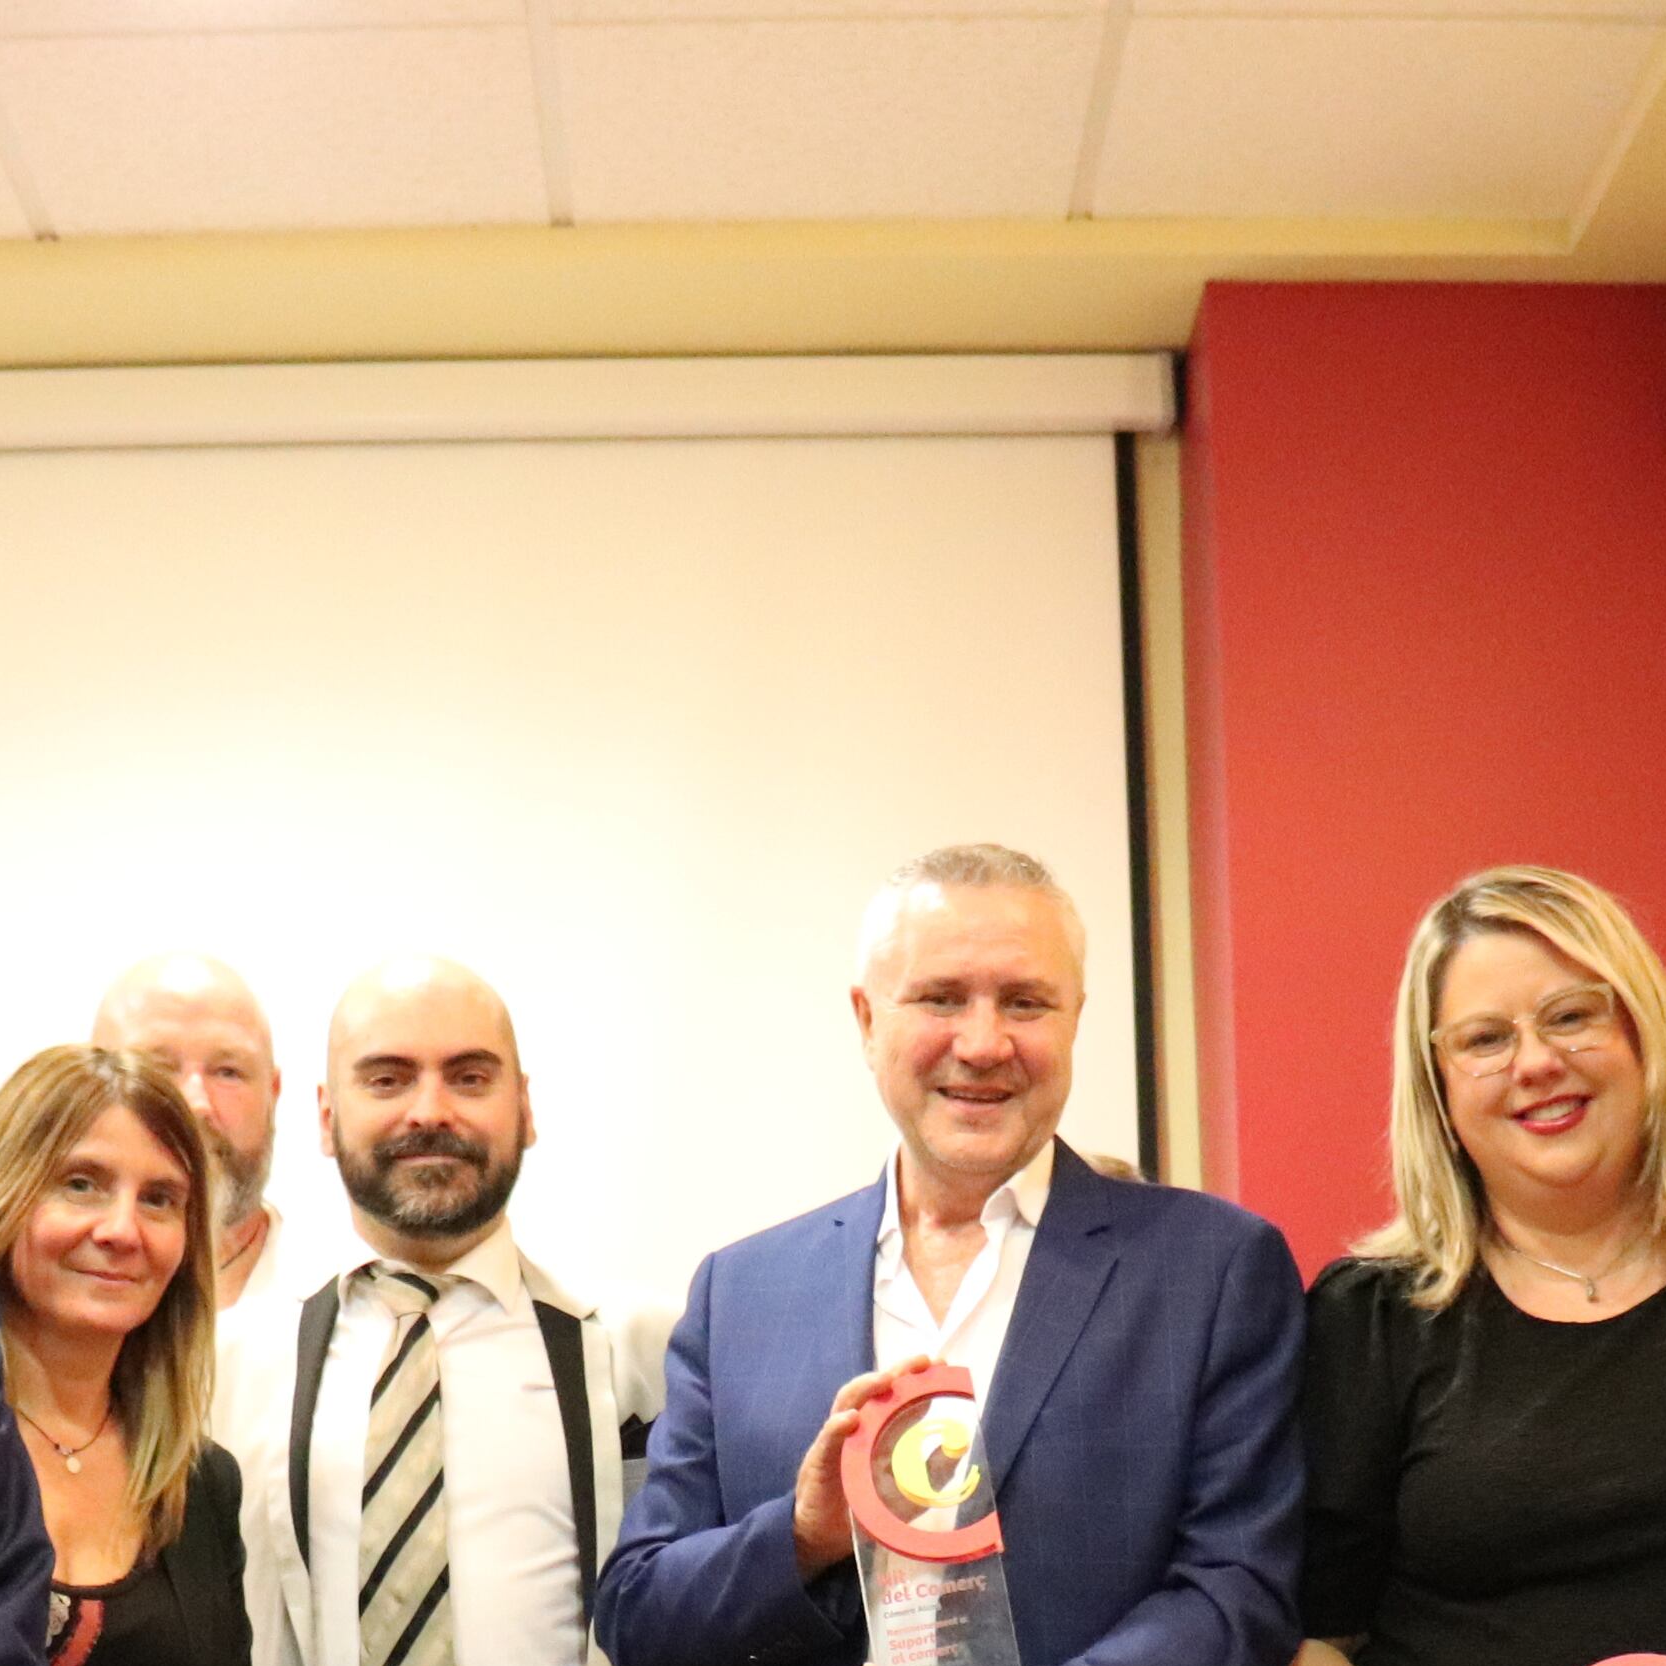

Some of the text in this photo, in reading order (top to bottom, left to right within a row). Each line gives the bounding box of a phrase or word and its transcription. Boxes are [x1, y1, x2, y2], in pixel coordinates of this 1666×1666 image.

[883, 1575, 988, 1605] del Comerç
[889, 1633, 937, 1650] Suport
